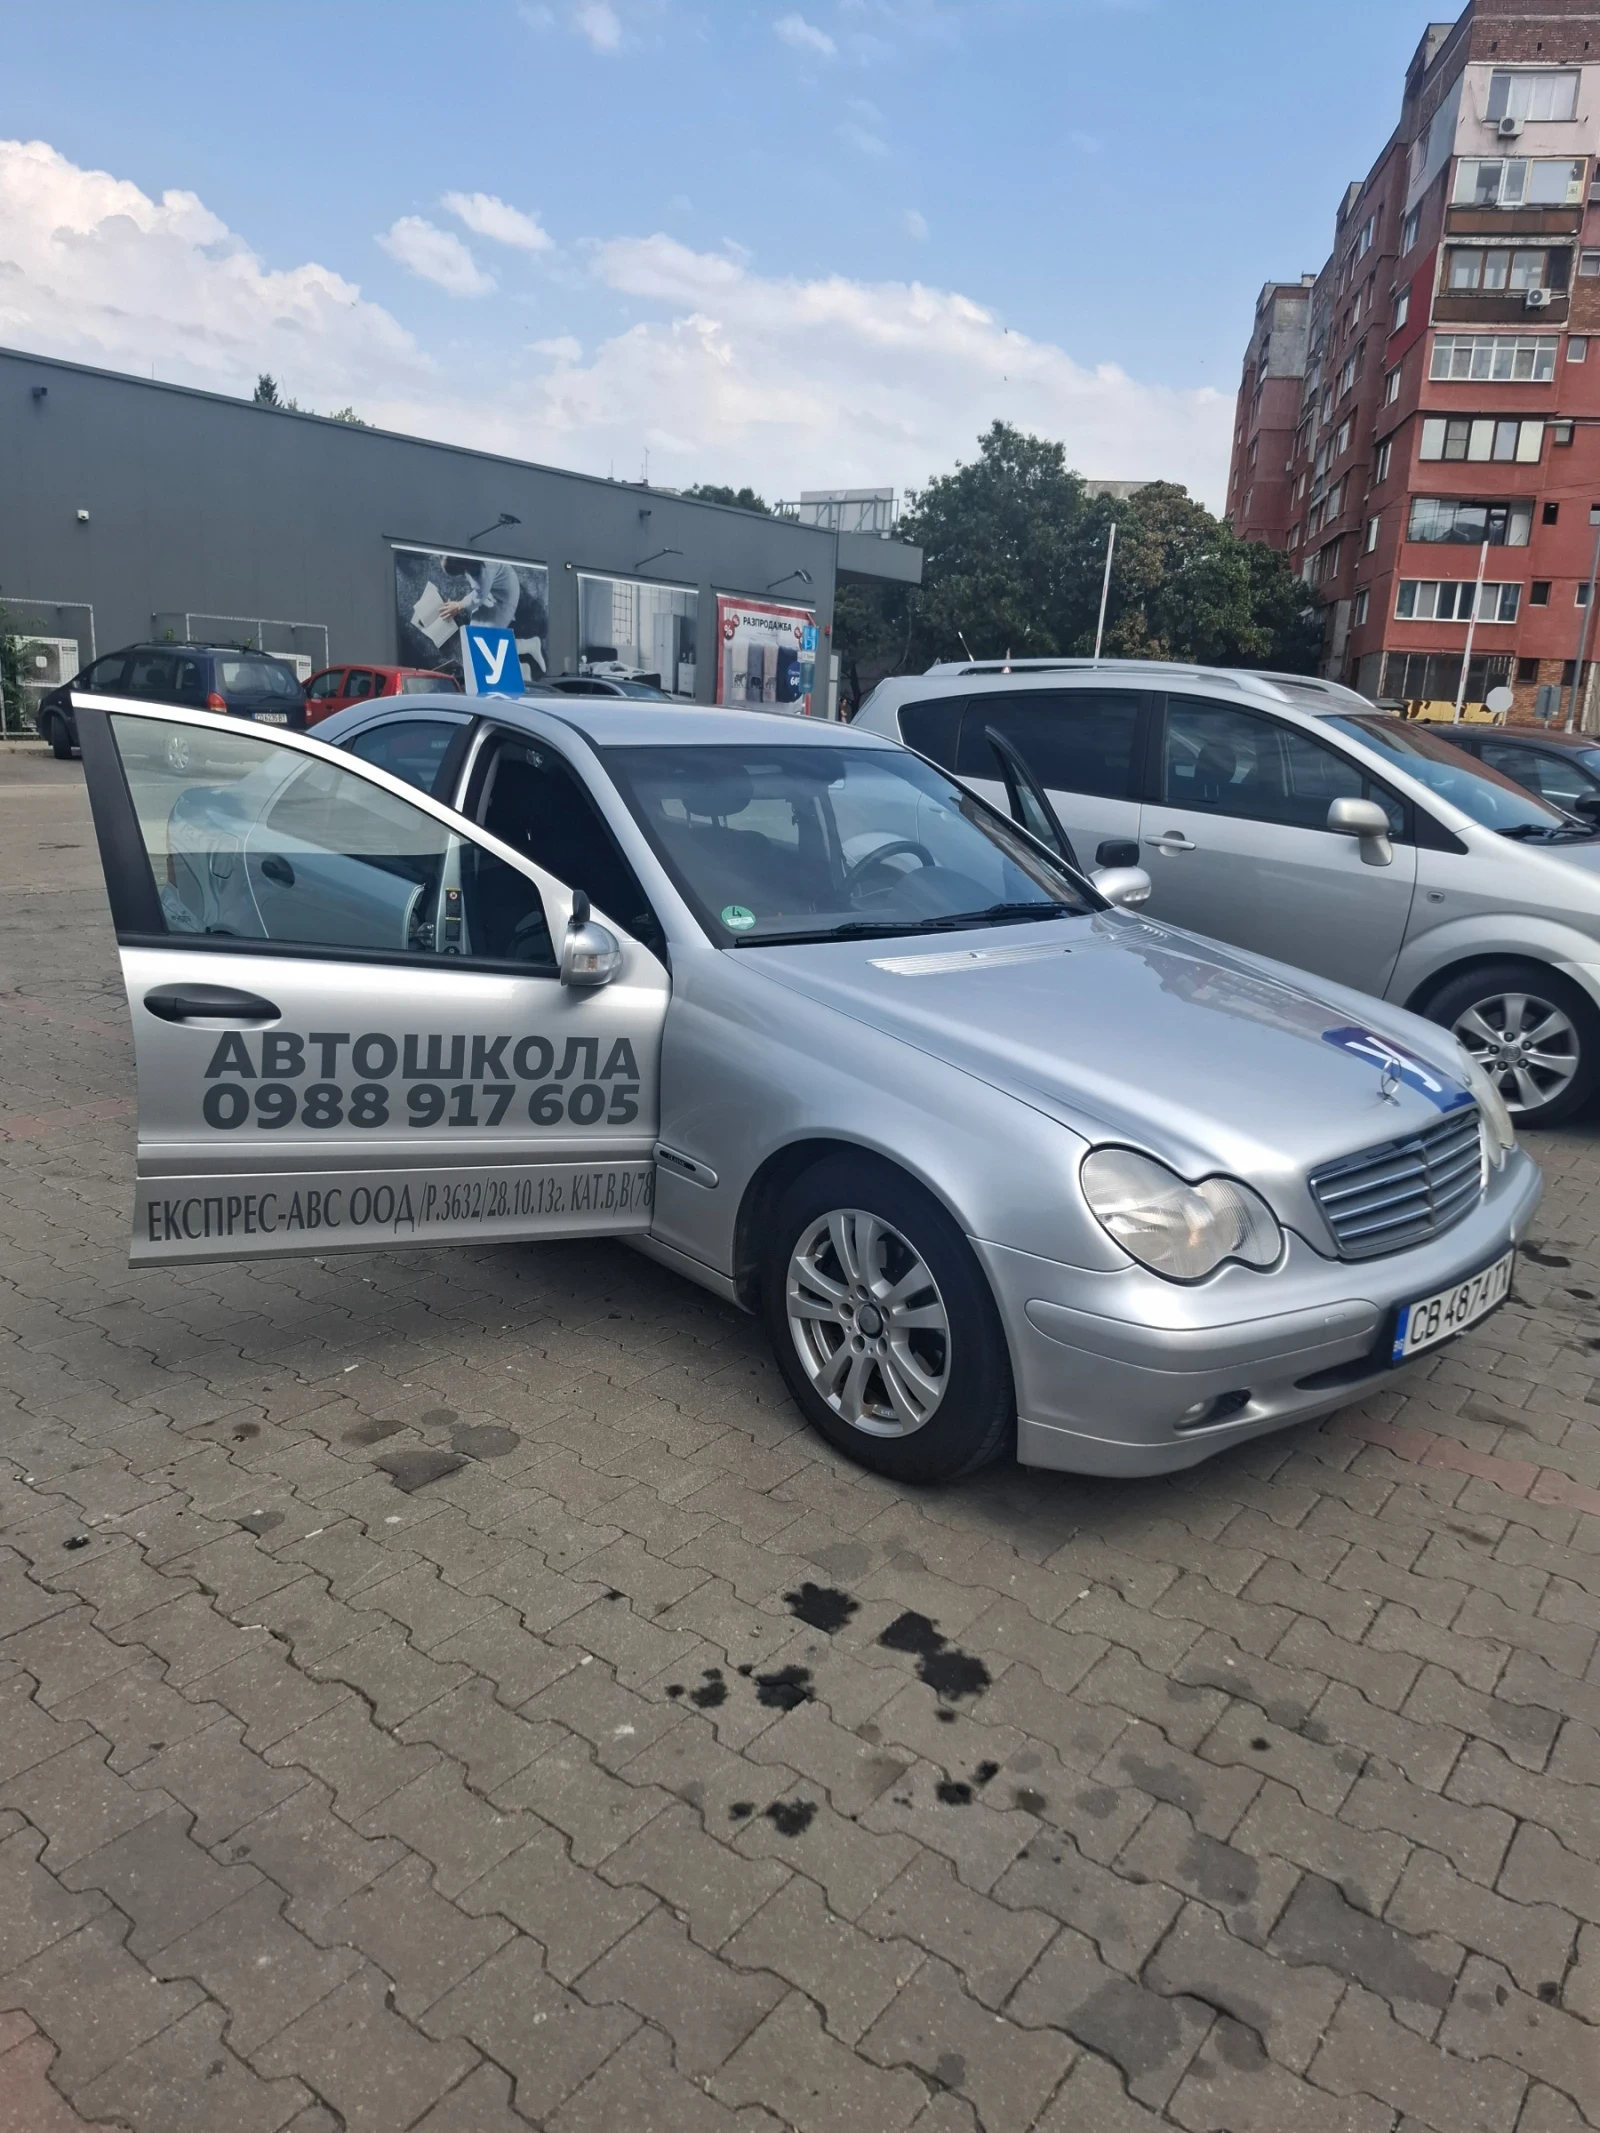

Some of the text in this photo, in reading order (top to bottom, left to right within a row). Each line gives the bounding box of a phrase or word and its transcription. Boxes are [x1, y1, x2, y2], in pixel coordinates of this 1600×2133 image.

[743, 616, 792, 632] РАЗПРОДАЖБА
[473, 636, 509, 684] У
[732, 906, 742, 917] 4
[204, 1031, 640, 1080] АВТОШКОЛА
[203, 1083, 640, 1130] 0988 917 605
